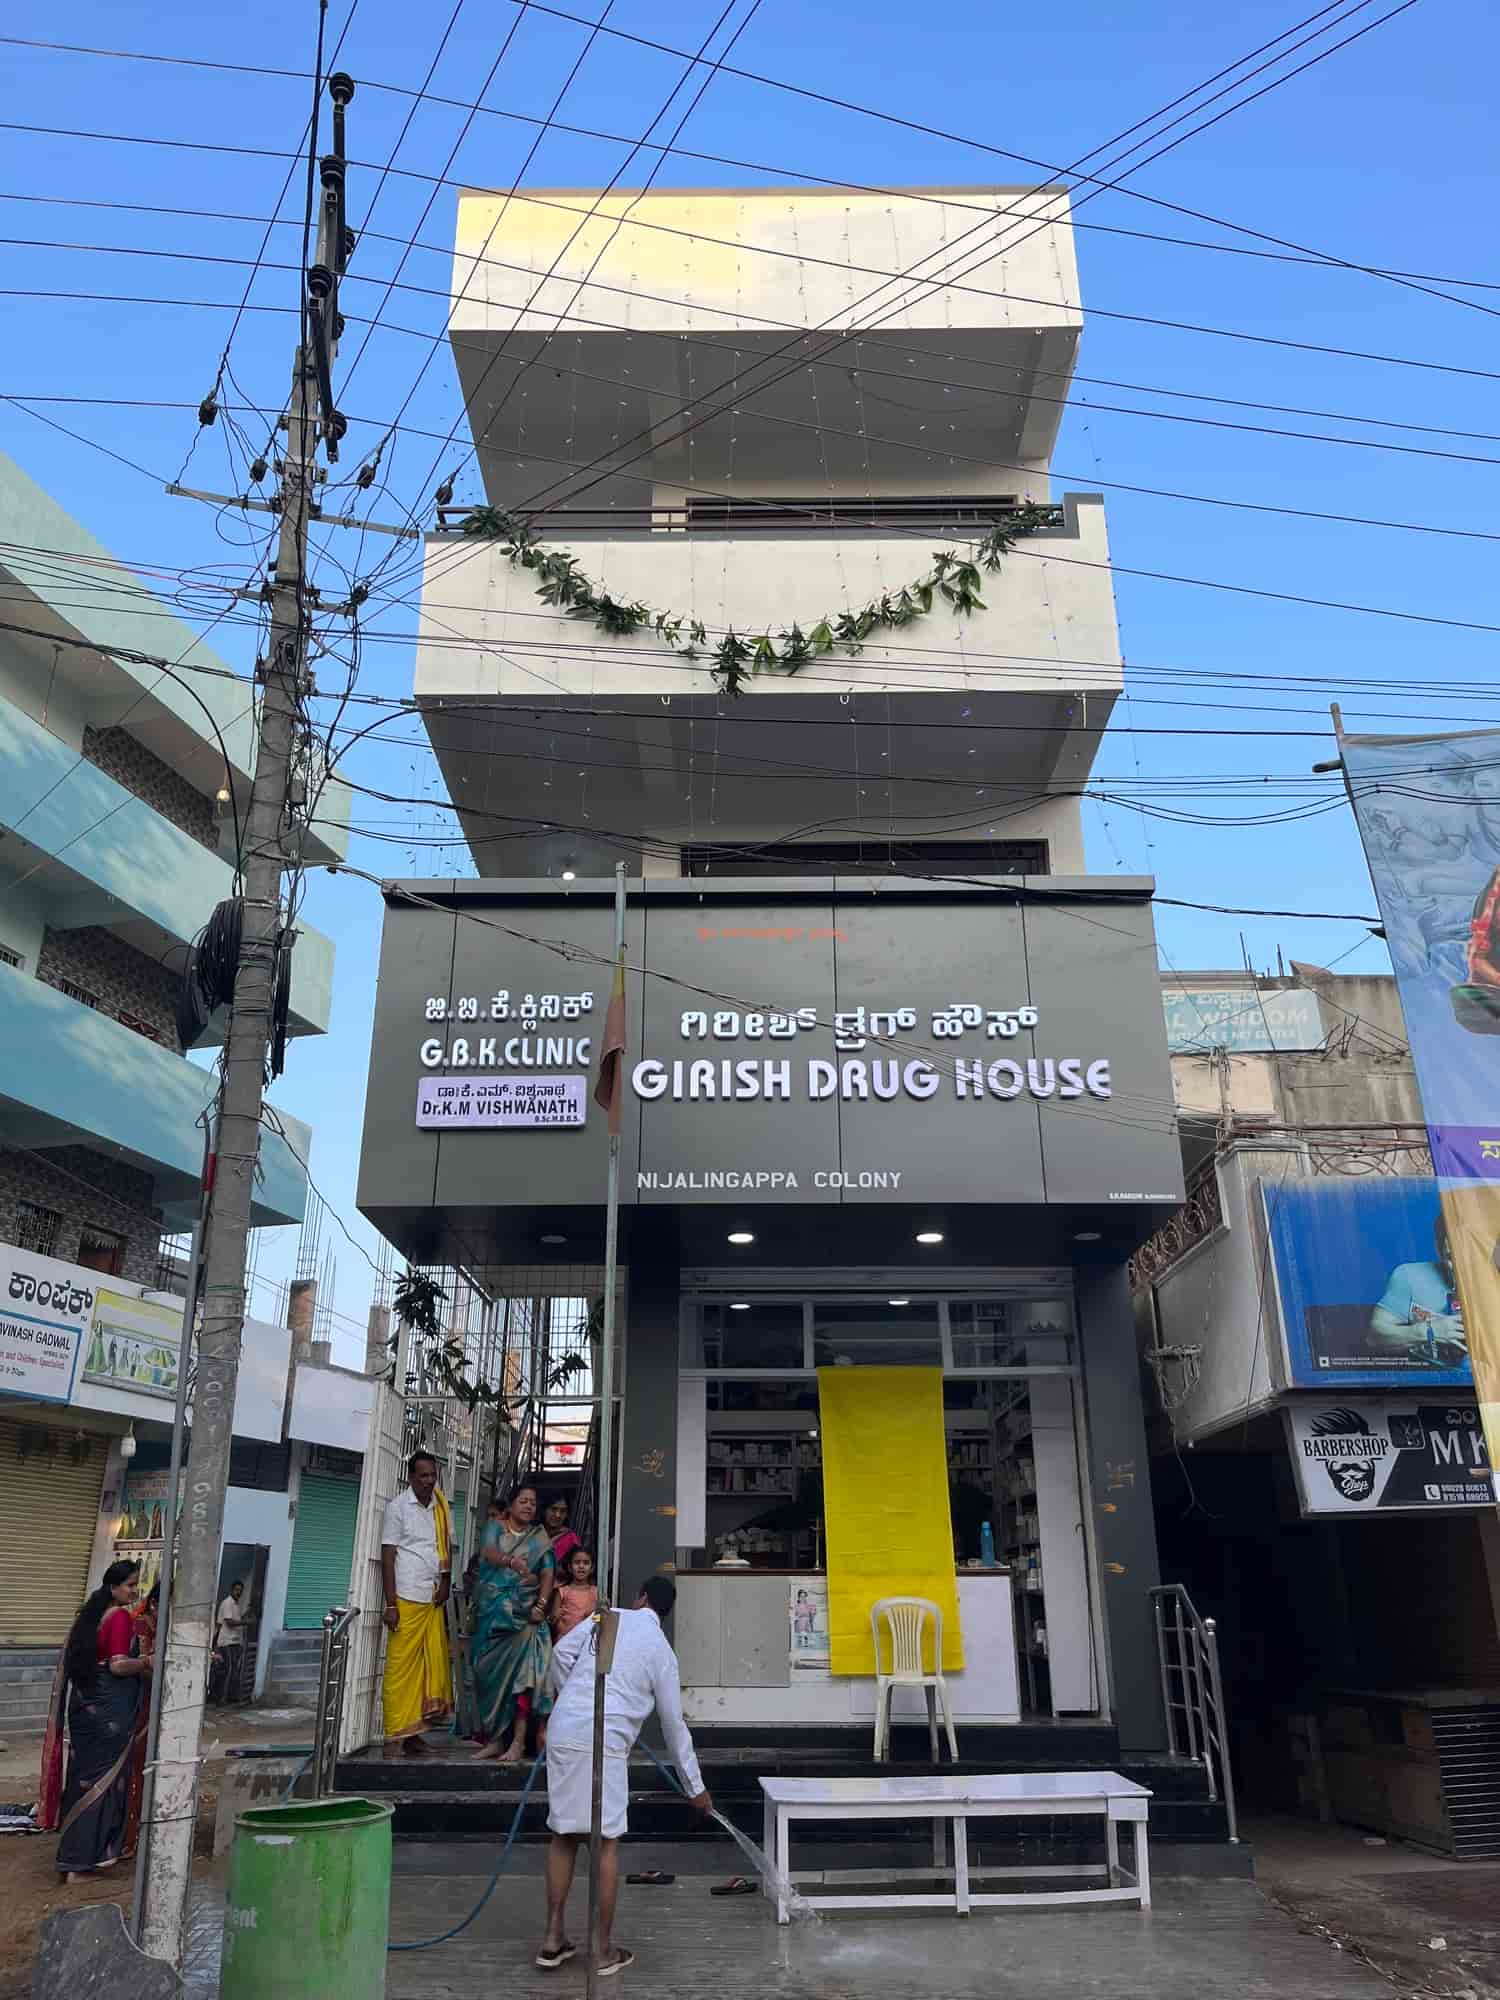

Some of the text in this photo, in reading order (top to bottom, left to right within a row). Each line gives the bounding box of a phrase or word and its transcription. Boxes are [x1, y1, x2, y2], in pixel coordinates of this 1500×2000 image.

[931, 1004, 1038, 1037] ಹೌಸ್
[631, 1058, 1112, 1099] GIRISH DRUG HOUSE
[477, 1098, 578, 1115] VISHWANATH
[637, 1171, 902, 1189] NIJALINGAPPA COLONY
[35, 1331, 71, 1350] GADWAL
[1303, 1437, 1389, 1457] BARBERSHOP
